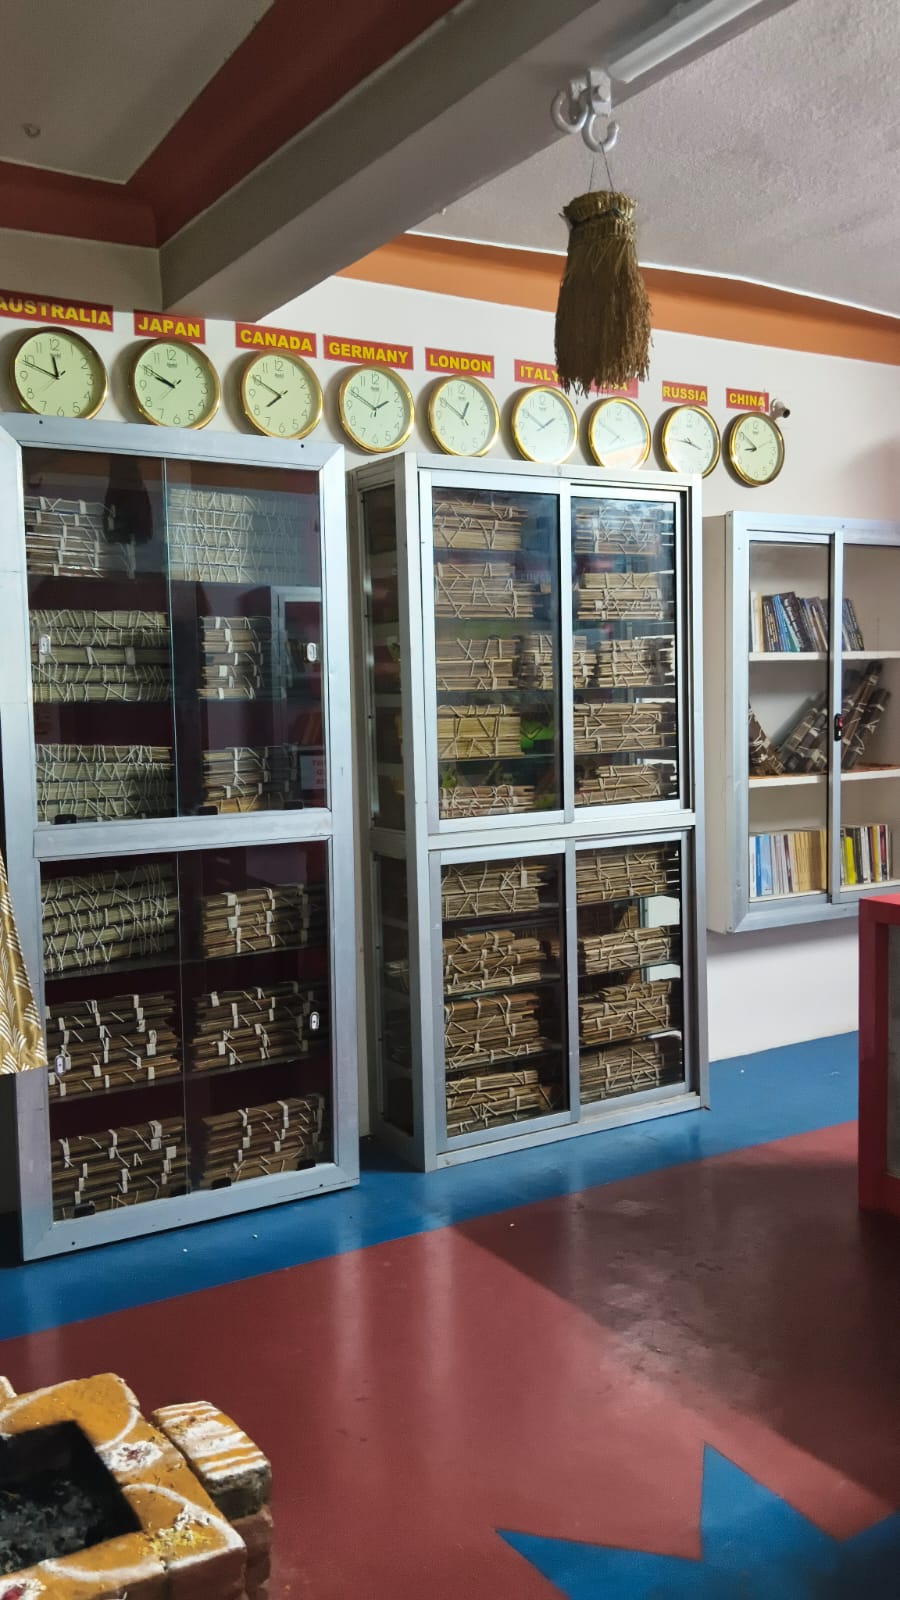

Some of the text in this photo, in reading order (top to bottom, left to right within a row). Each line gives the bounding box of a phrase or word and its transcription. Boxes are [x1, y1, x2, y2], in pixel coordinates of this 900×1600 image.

[0, 296, 111, 326] AUSTRALIA
[138, 317, 200, 338] JAPAN
[240, 329, 312, 352] CANADA
[328, 342, 408, 364] GERMANY
[429, 353, 491, 374] LONDON
[520, 365, 559, 382] ITALY
[662, 385, 707, 402] RUSSIA
[729, 393, 766, 408] CHINA
